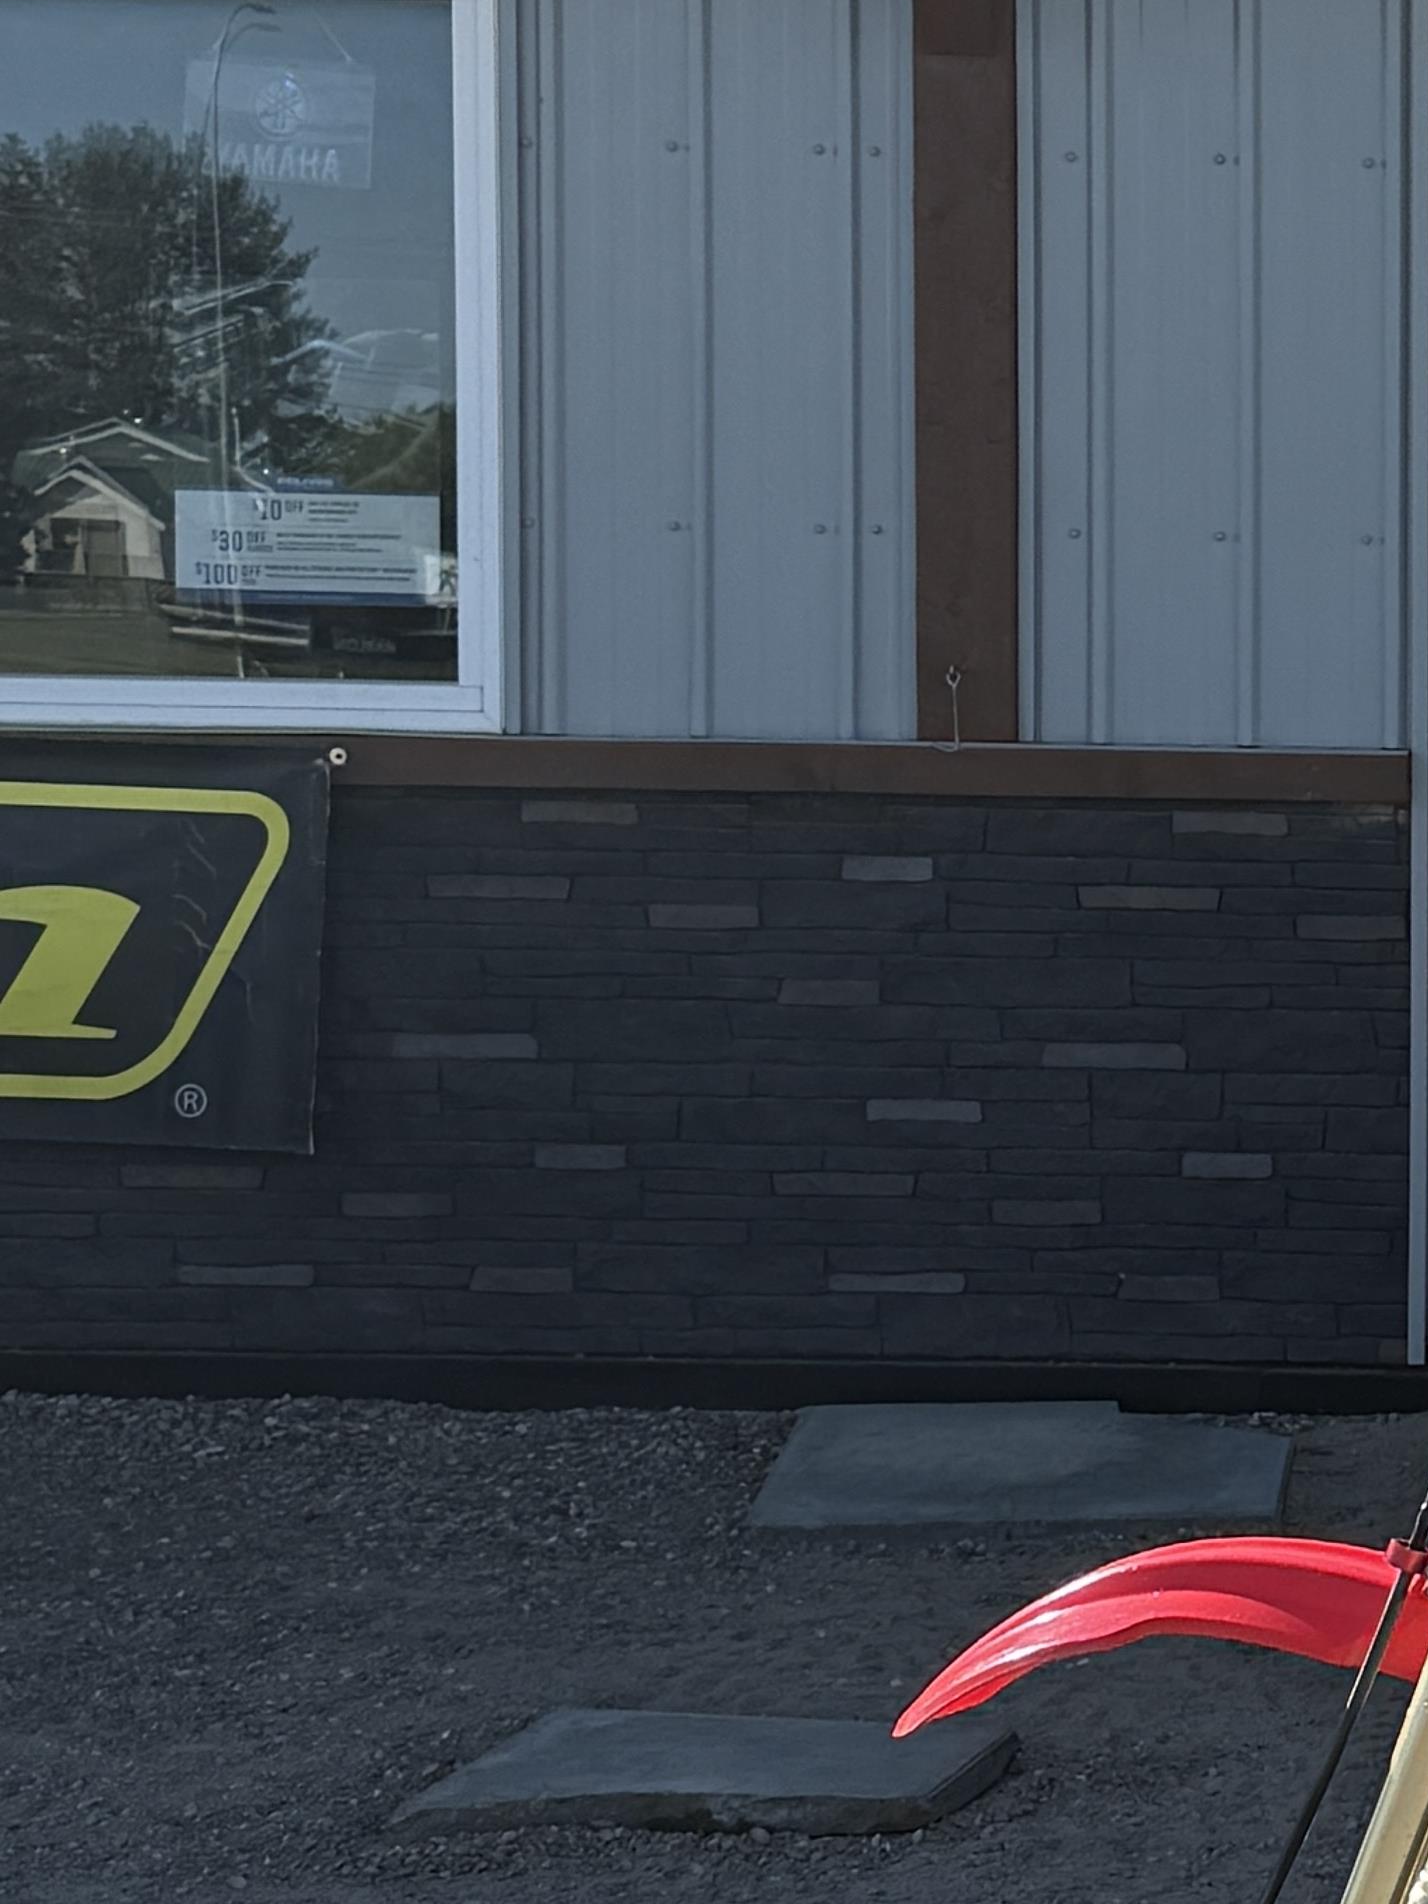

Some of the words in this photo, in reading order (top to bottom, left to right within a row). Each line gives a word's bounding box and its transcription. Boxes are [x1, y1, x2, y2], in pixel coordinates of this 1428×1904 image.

[285, 500, 304, 513] OFF
[212, 529, 243, 552] $30
[247, 531, 266, 543] OFF
[196, 562, 238, 585] $100
[241, 565, 262, 578] OFF
